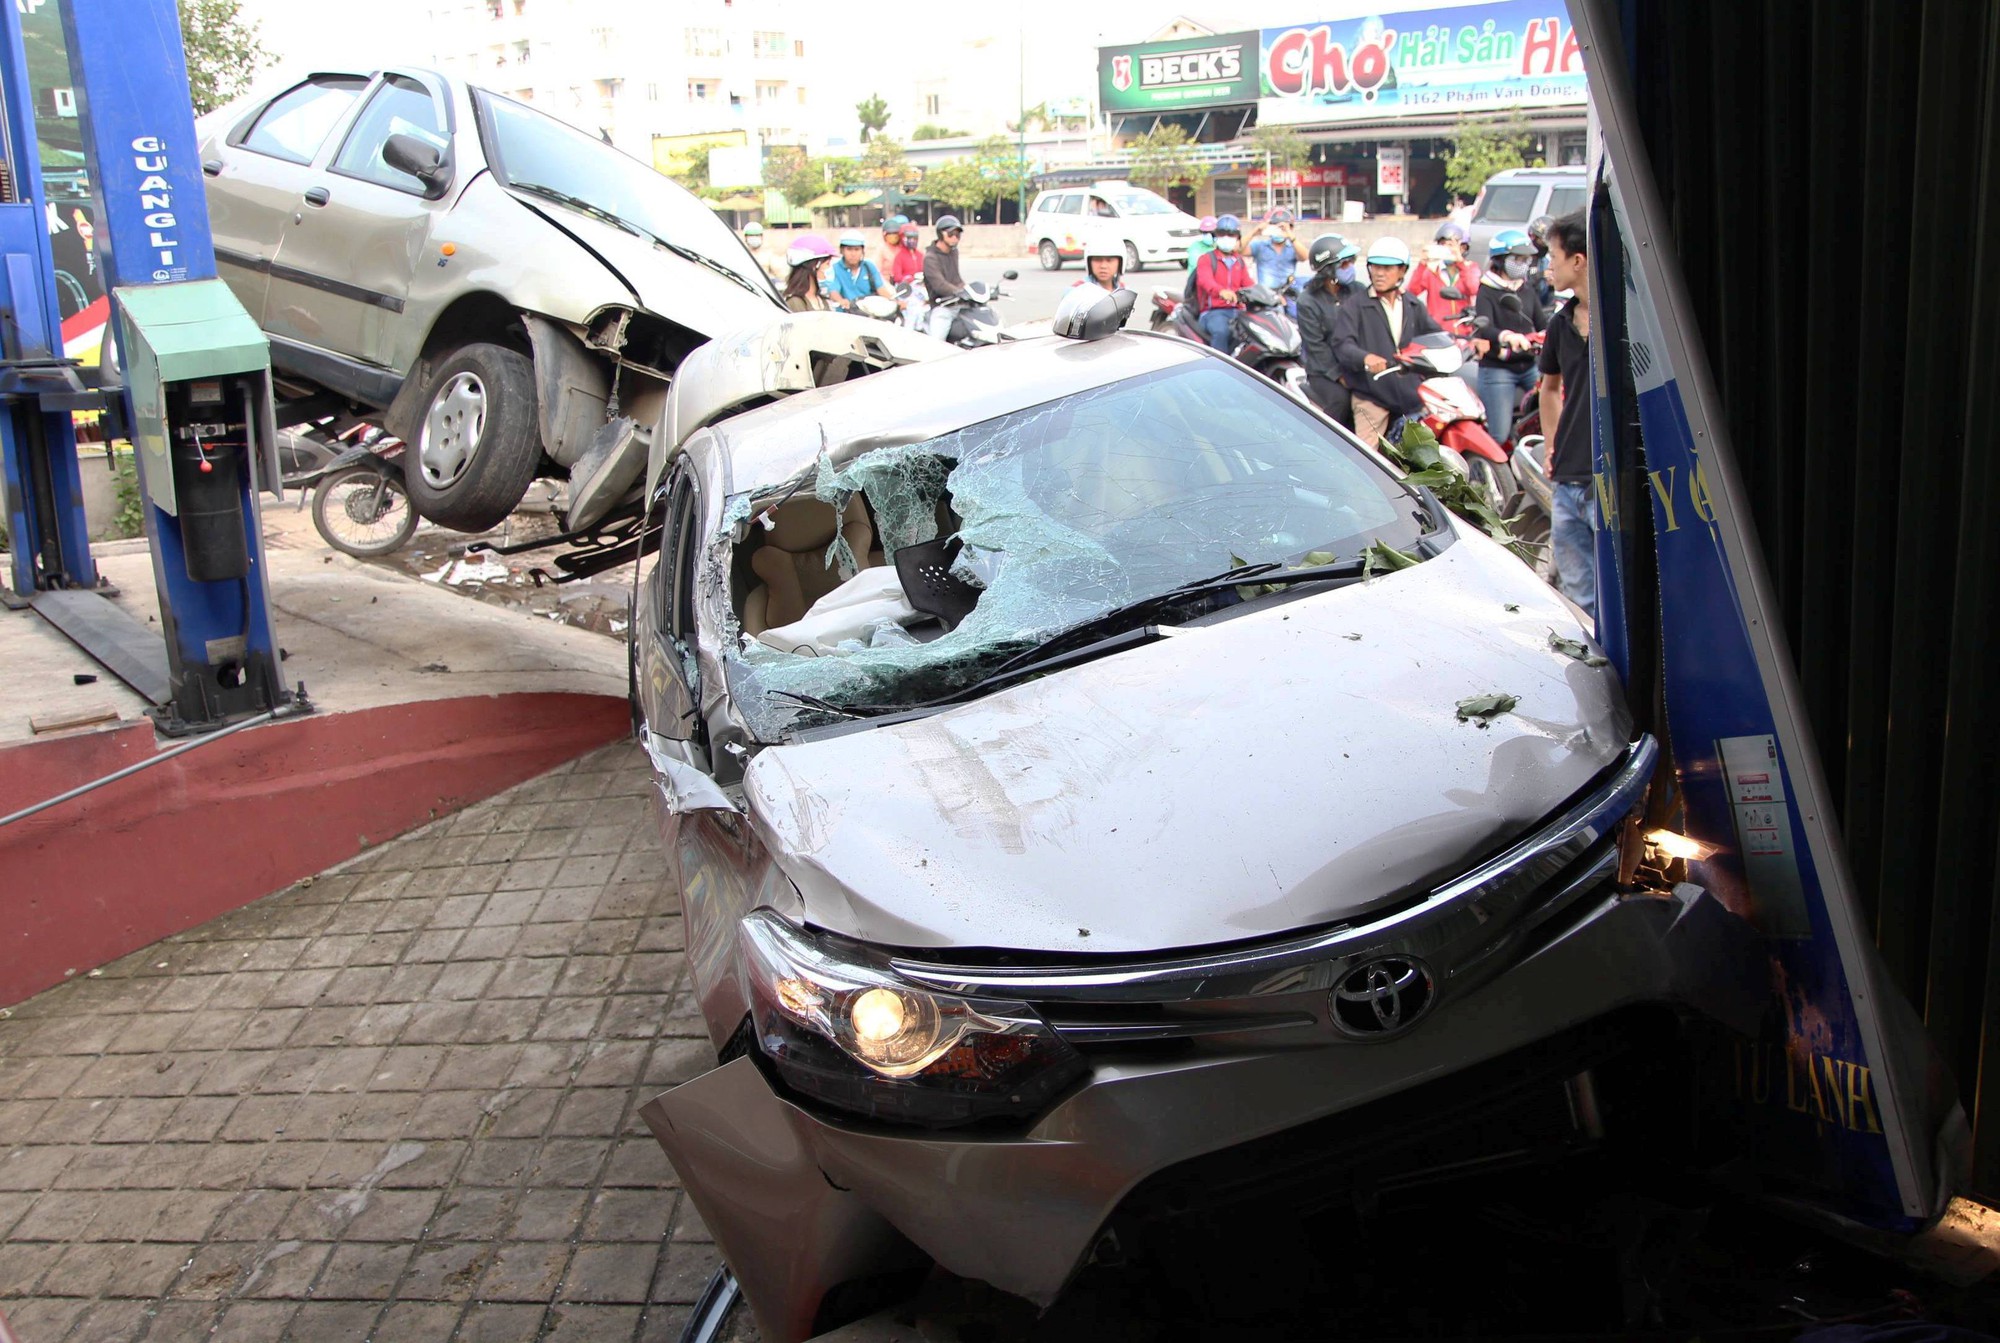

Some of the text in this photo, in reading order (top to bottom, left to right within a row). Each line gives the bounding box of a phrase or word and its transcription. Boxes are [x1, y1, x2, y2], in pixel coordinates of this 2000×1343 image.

[1142, 49, 1240, 85] BECK'S
[1269, 29, 1393, 101] Chợ
[1399, 27, 1448, 68] Hải
[1457, 22, 1514, 64] Sản
[131, 136, 178, 266] GUANGLI
